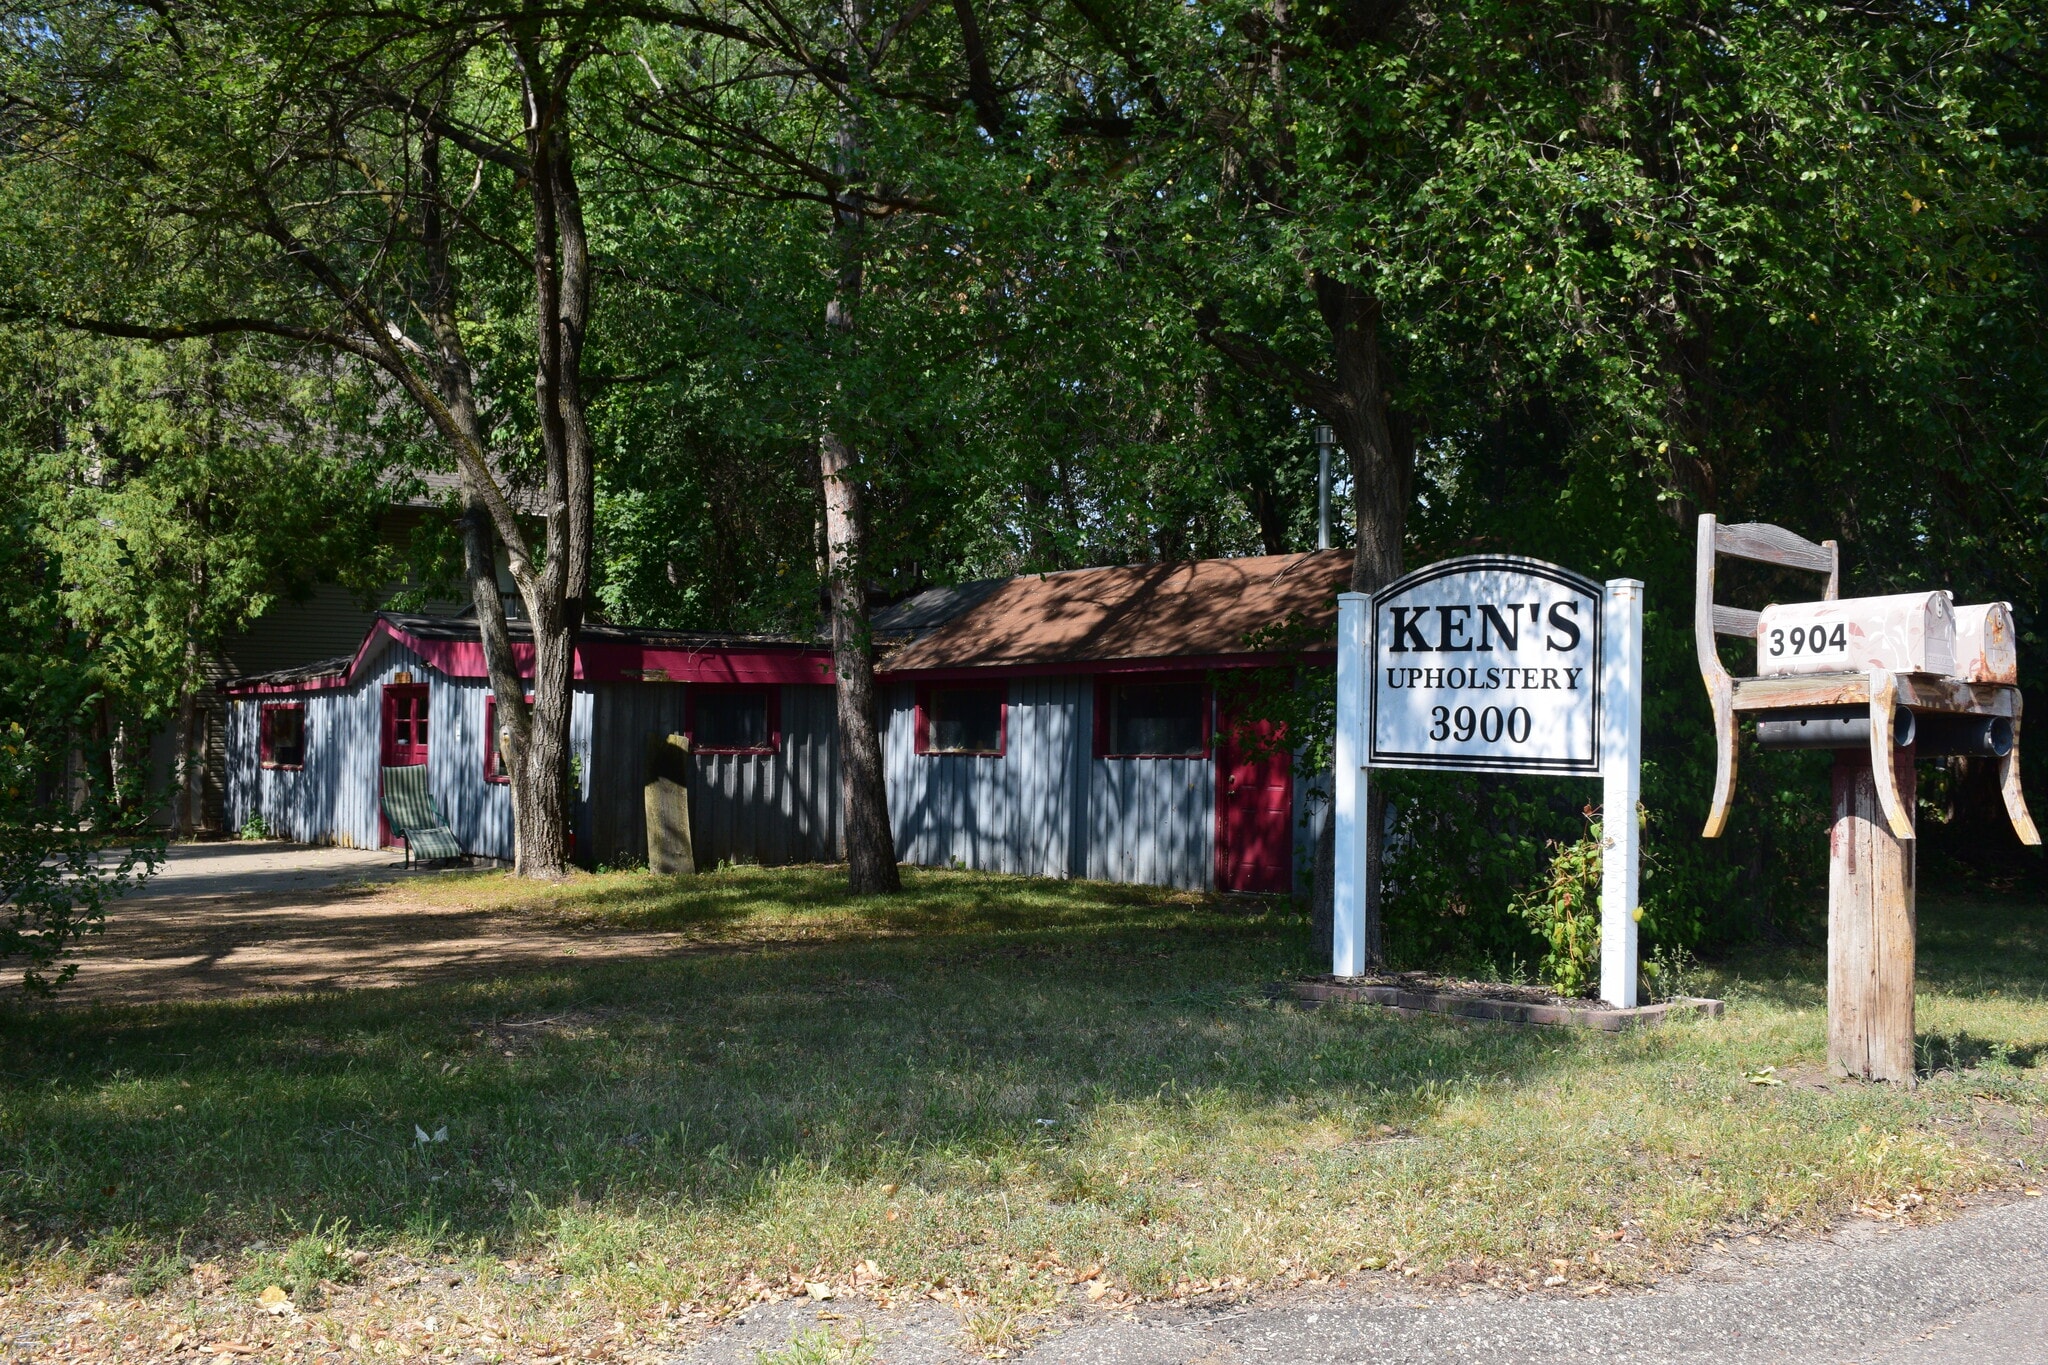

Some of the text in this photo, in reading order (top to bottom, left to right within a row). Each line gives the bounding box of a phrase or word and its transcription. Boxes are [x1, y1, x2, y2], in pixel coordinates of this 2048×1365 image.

[1389, 601, 1581, 652] KEN'S
[1769, 623, 1847, 657] 3904
[1387, 667, 1583, 689] UPHOLSTERY
[1430, 706, 1532, 743] 3900
